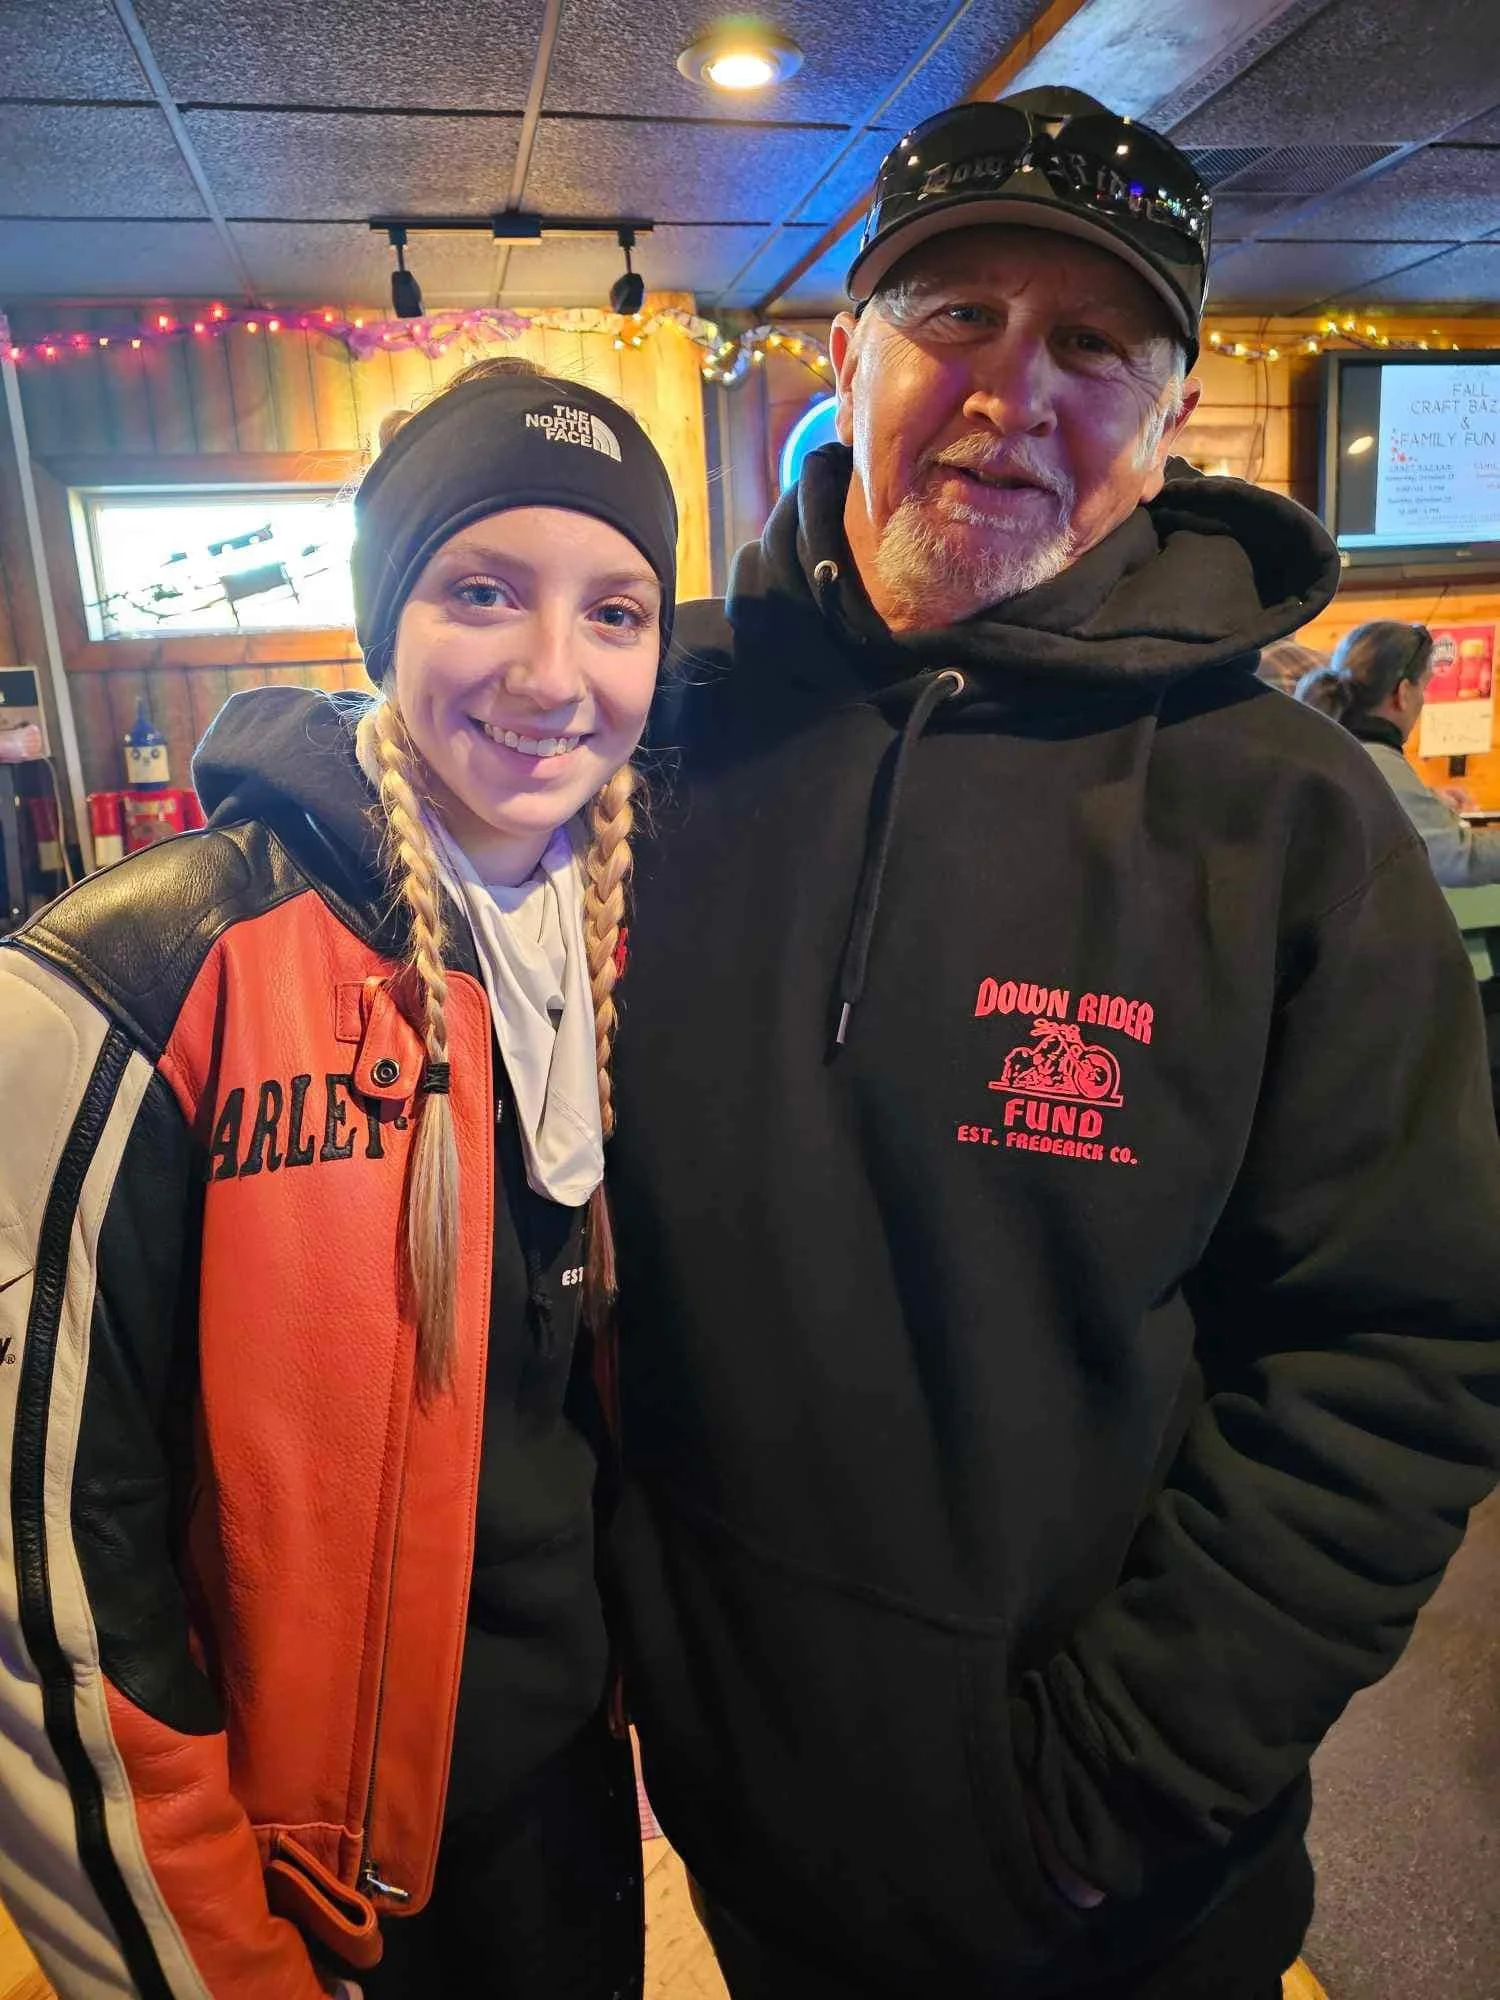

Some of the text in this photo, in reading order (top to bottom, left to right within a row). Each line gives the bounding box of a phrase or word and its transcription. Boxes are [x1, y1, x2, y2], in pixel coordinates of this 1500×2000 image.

[1452, 382, 1491, 398] FALL
[553, 404, 589, 421] THE
[1410, 399, 1500, 415] CRAFT BAZ
[525, 413, 590, 435] NORTH
[545, 427, 593, 448] FACE
[1400, 431, 1497, 448] FAMILY FUN
[974, 976, 1154, 1045] DOWN RIDER
[1004, 1098, 1103, 1138] FUND
[957, 1124, 1138, 1164] EST. FREDERICK CO.
[561, 1266, 584, 1286] EST
